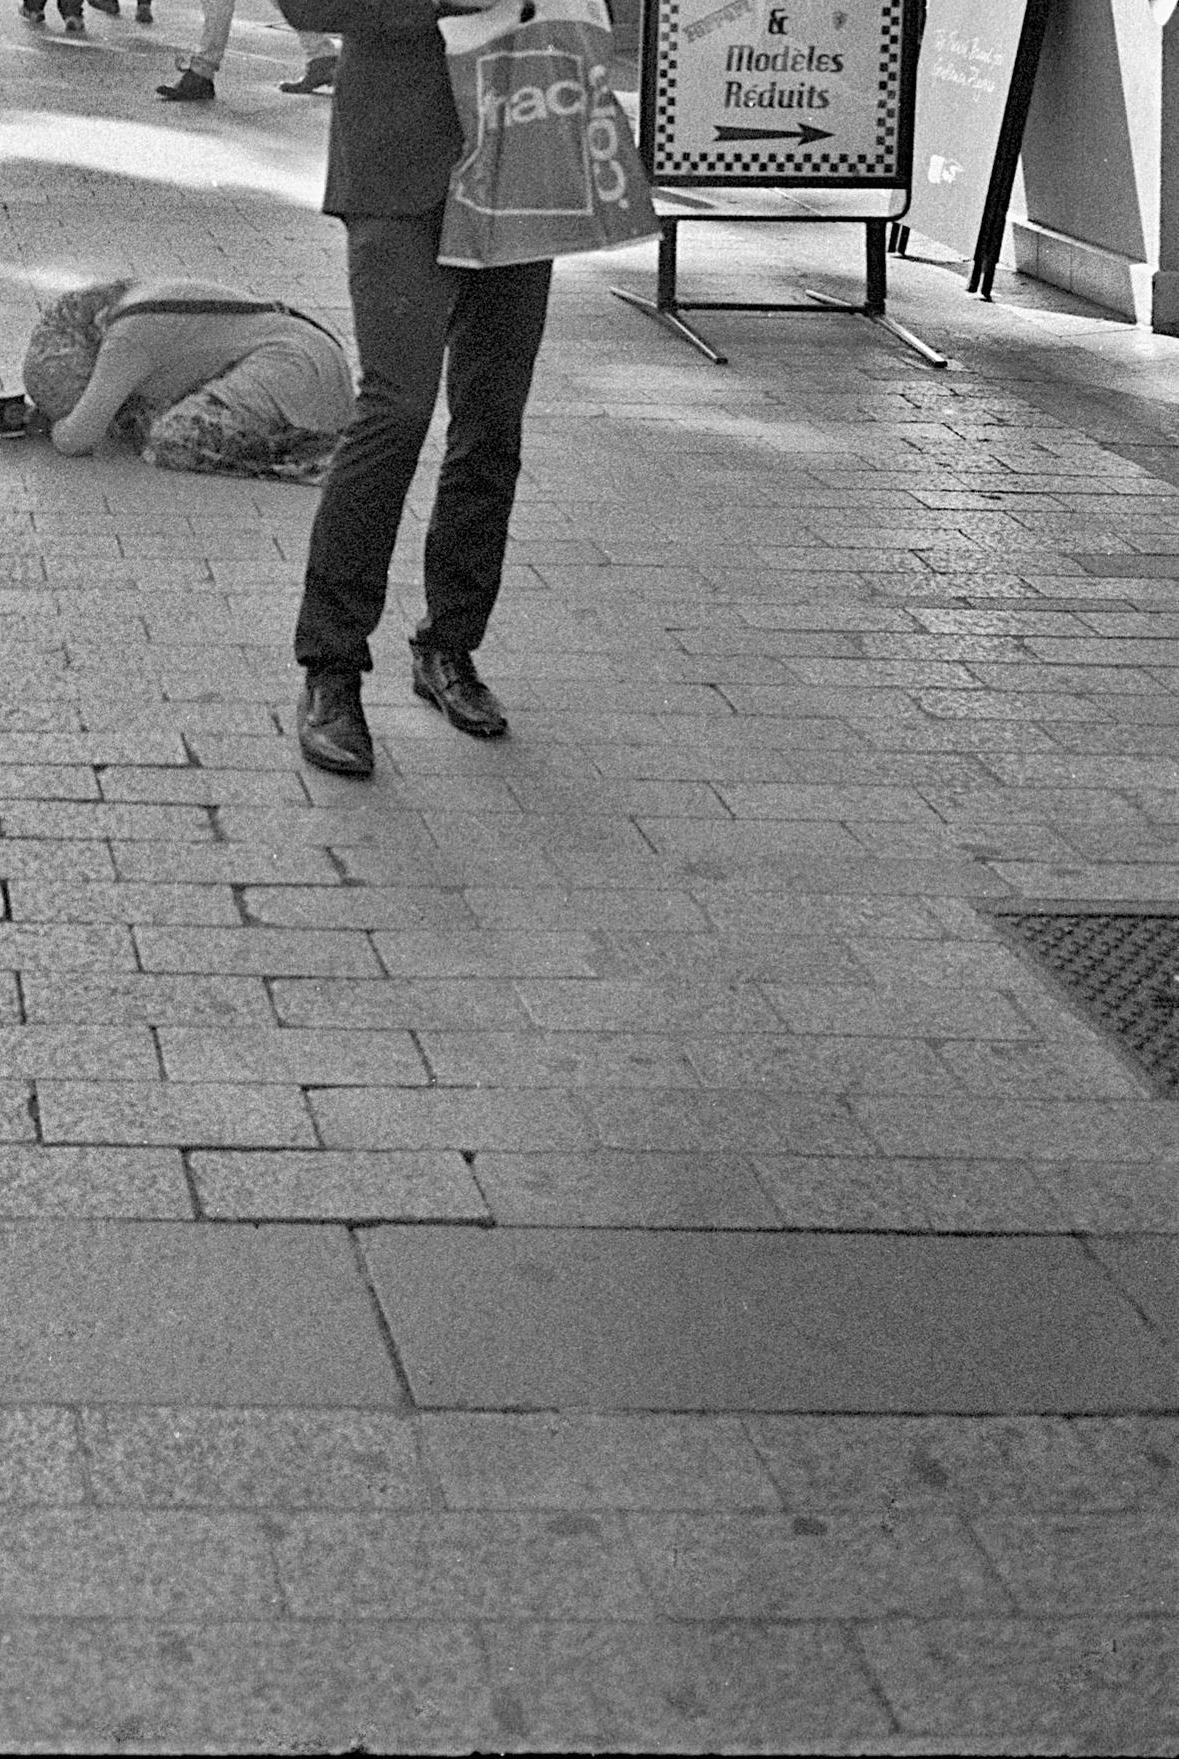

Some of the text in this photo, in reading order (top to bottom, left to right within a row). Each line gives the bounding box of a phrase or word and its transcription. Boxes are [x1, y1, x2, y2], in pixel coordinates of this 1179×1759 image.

[767, 8, 788, 35] &
[725, 44, 844, 73] Modèles
[724, 80, 830, 109] Réduits
